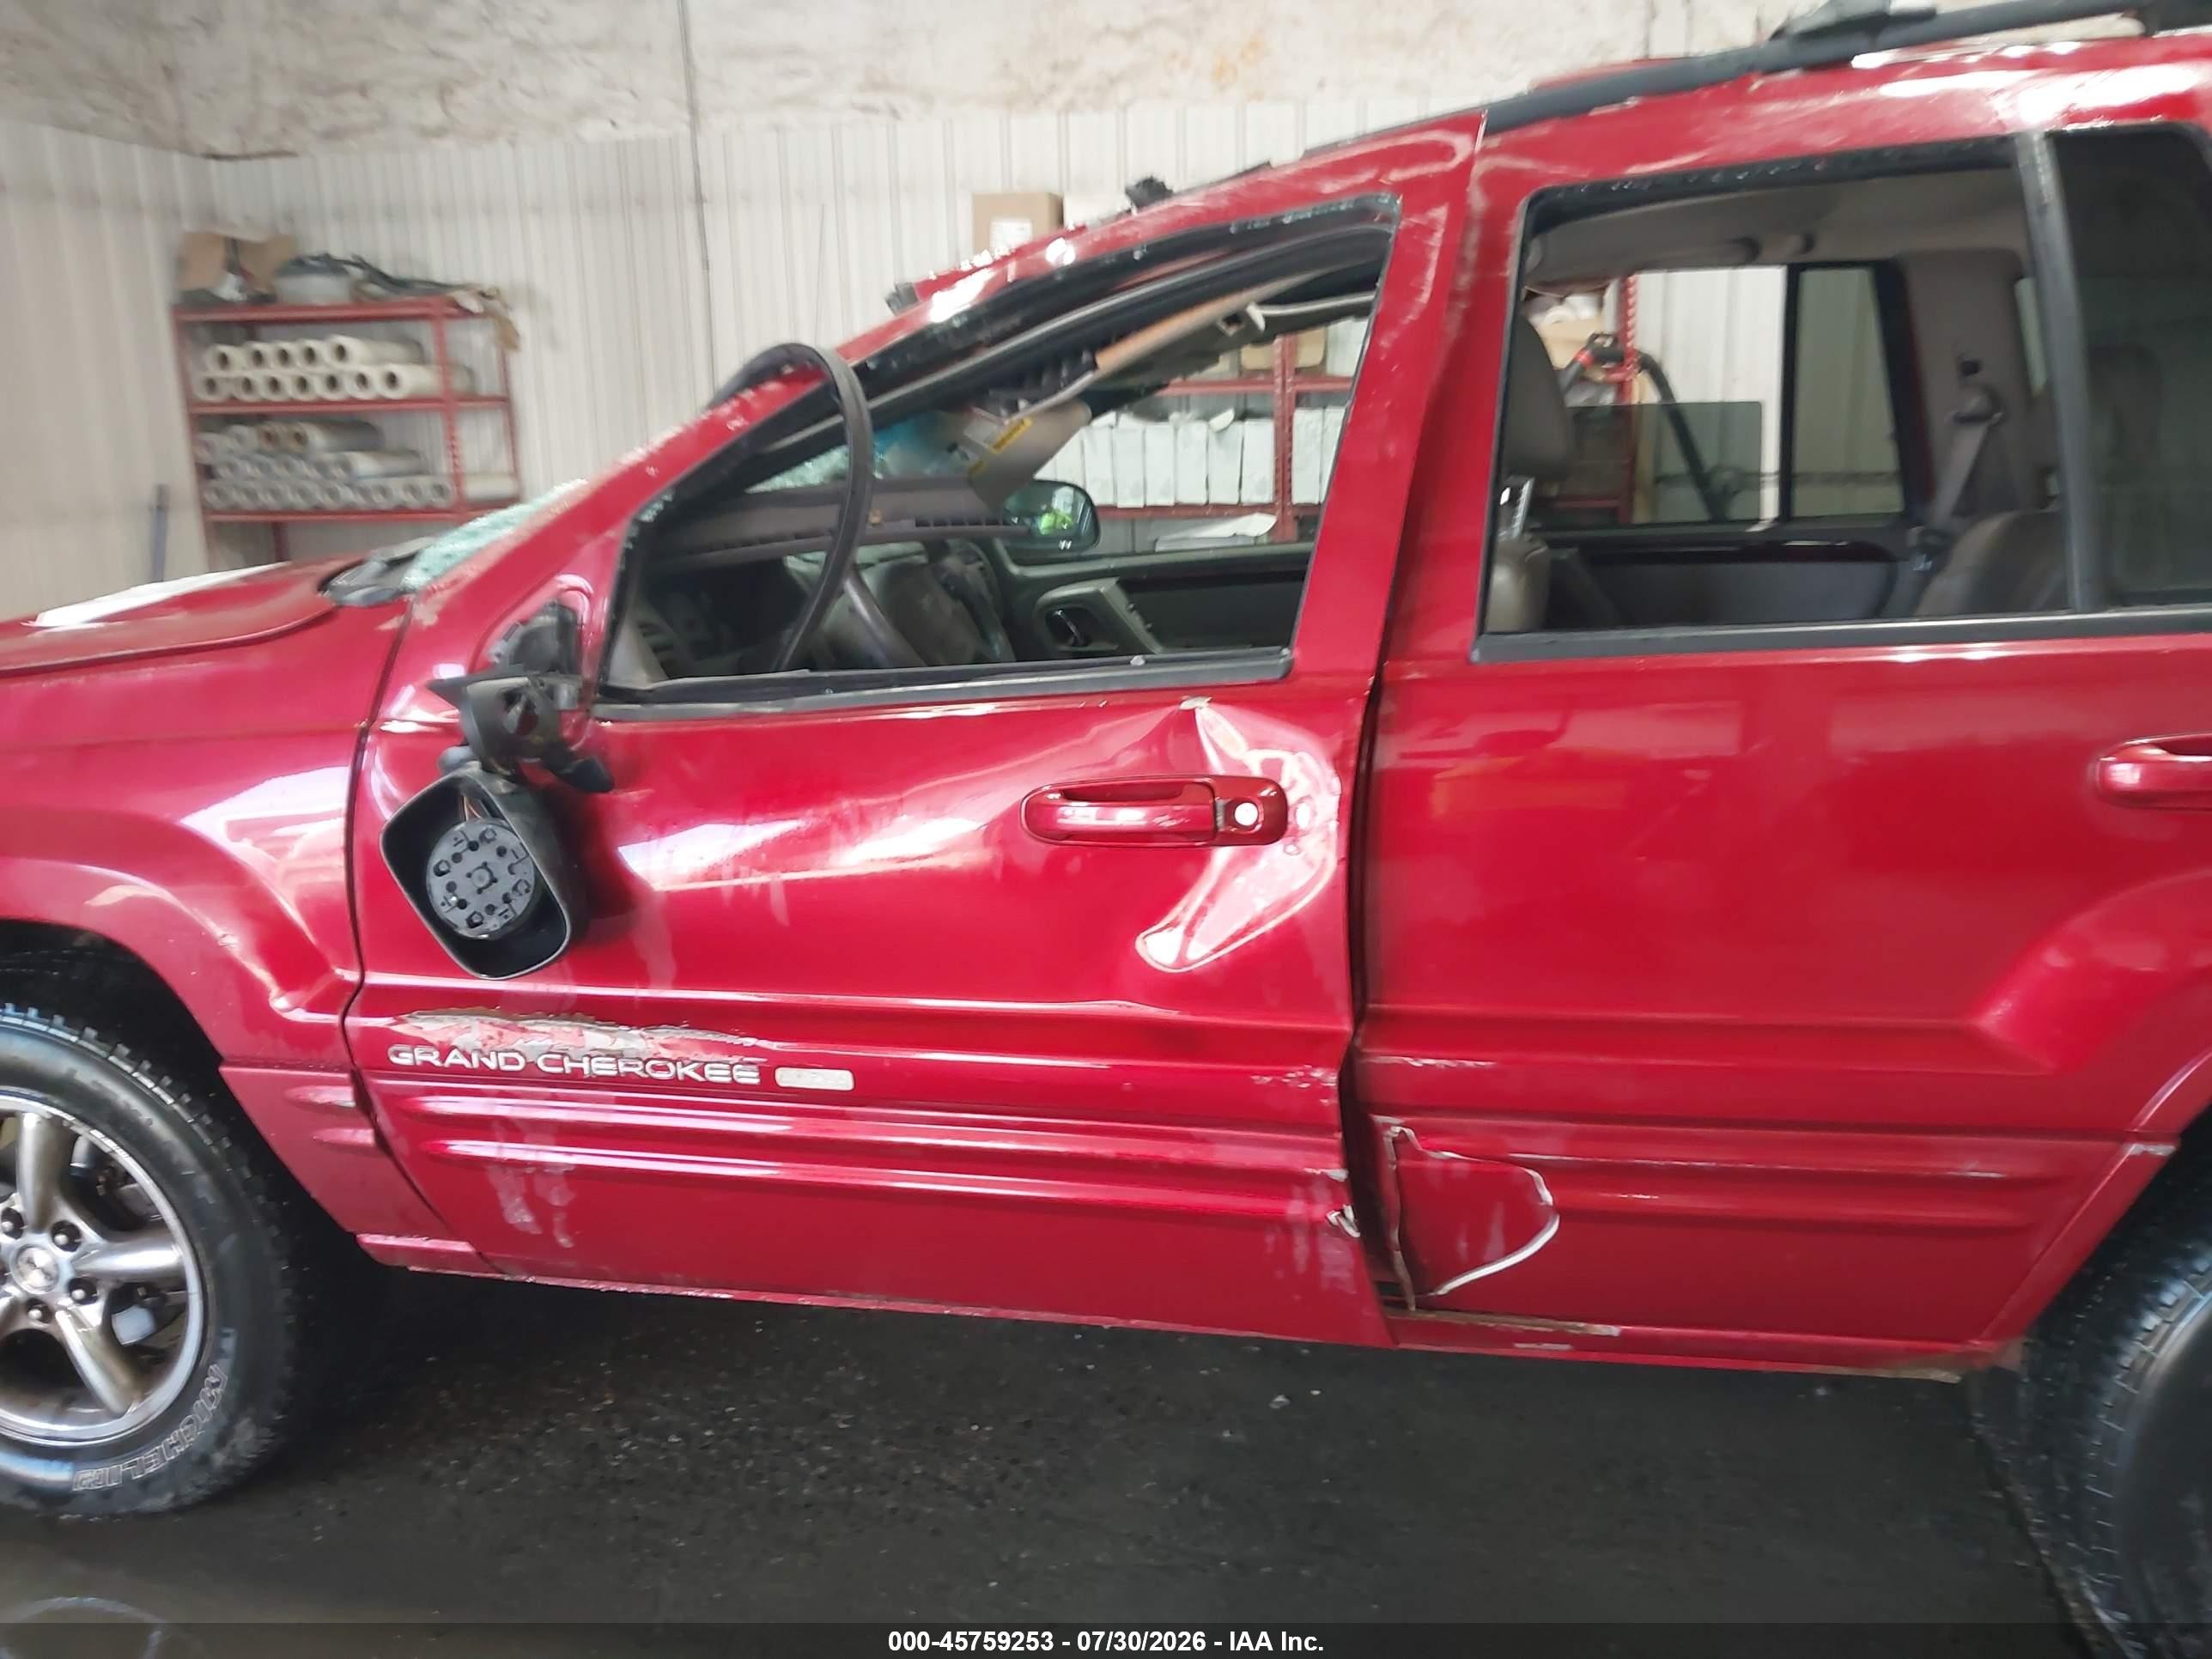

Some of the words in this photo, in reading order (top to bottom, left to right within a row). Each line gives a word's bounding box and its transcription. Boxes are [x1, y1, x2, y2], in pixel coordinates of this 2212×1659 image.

[387, 1044, 526, 1072] GRAND
[536, 1050, 761, 1085] CHEROKEE
[72, 1364, 228, 1491] MICHELIN
